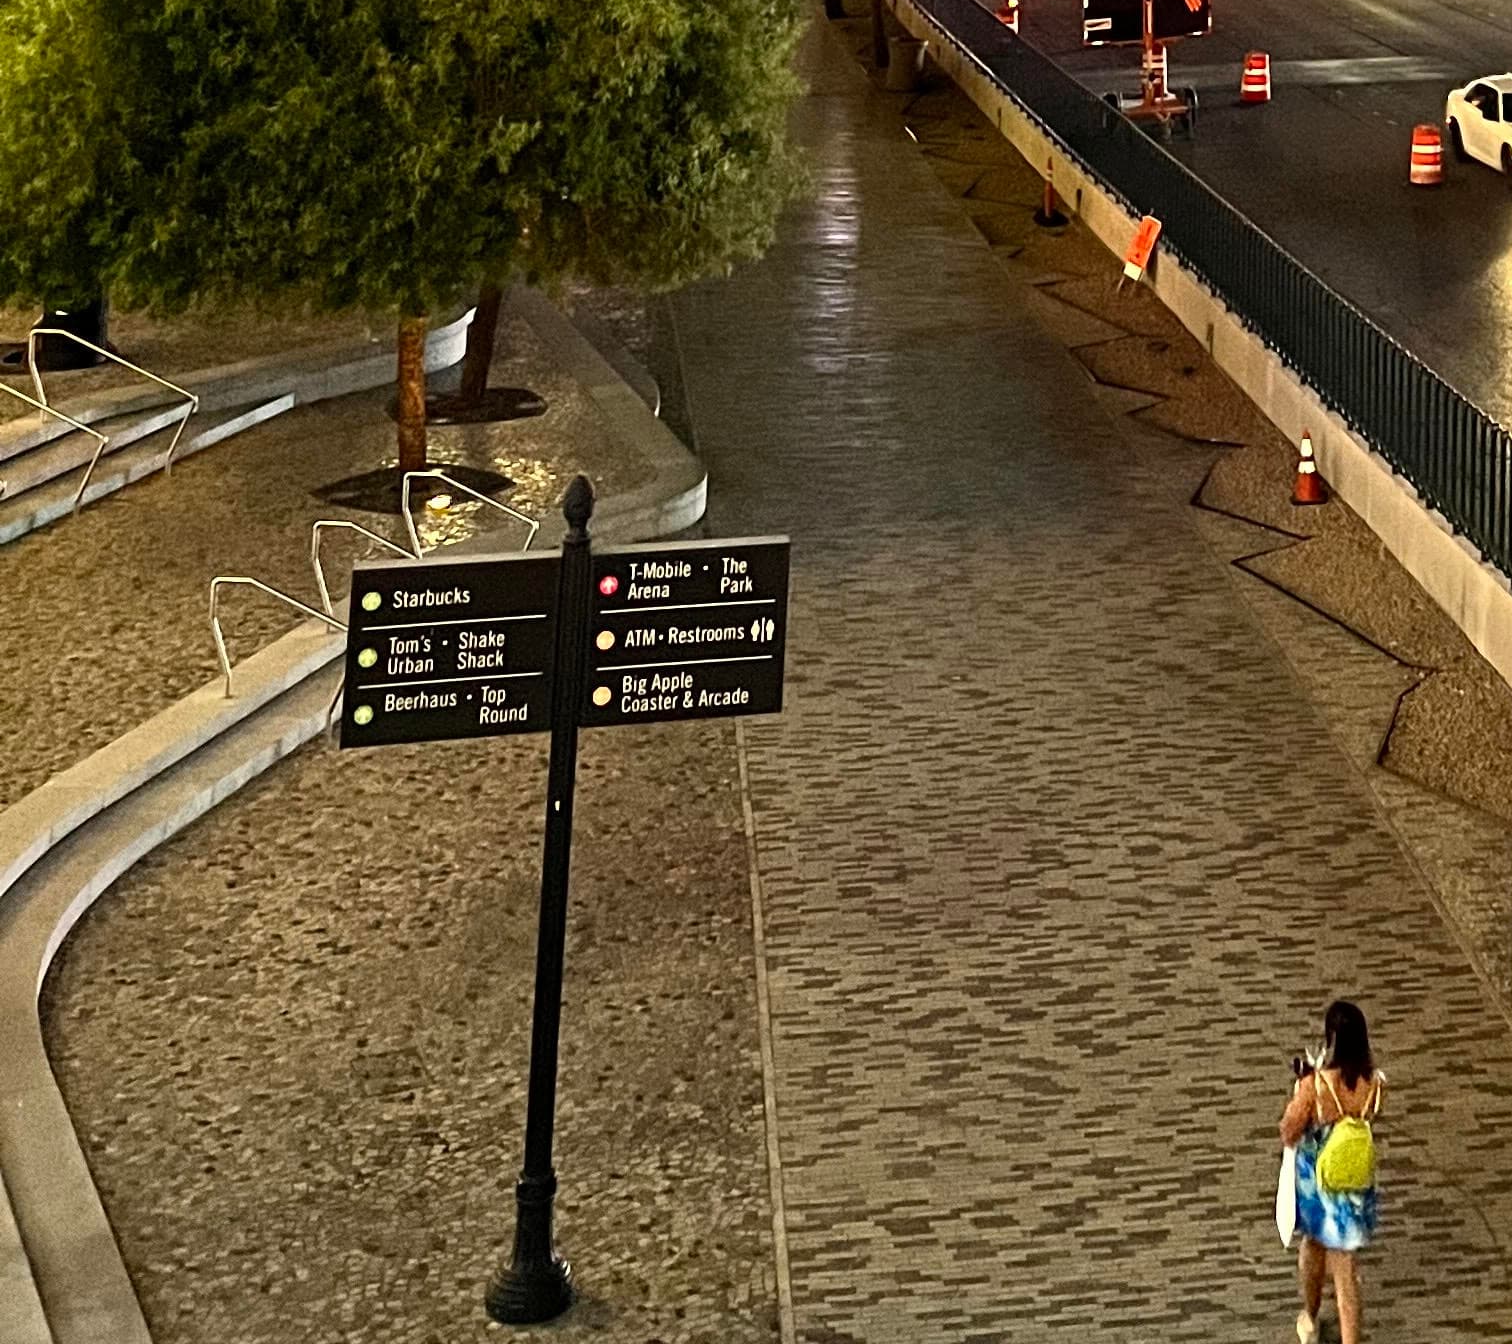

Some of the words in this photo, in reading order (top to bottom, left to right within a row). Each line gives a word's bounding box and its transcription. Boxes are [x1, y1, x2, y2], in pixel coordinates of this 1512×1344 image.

[629, 561, 692, 581] T-Mobile
[721, 557, 747, 574] The
[627, 582, 670, 600] Arena
[720, 575, 753, 594] Park
[393, 587, 470, 609] Starbucks
[388, 634, 431, 655] Tom's
[458, 630, 505, 650] Shake
[625, 629, 656, 648] ATM
[668, 626, 745, 645] Restrooms
[387, 657, 434, 676] Urban
[457, 650, 504, 670] Shack
[622, 675, 647, 695] Big
[651, 671, 694, 693] Apple
[385, 691, 458, 712] Beerhaus
[481, 685, 506, 706] Top
[621, 693, 679, 714] Coaster
[682, 690, 694, 709] &
[698, 687, 750, 707] Arcade
[479, 704, 528, 725] Round
